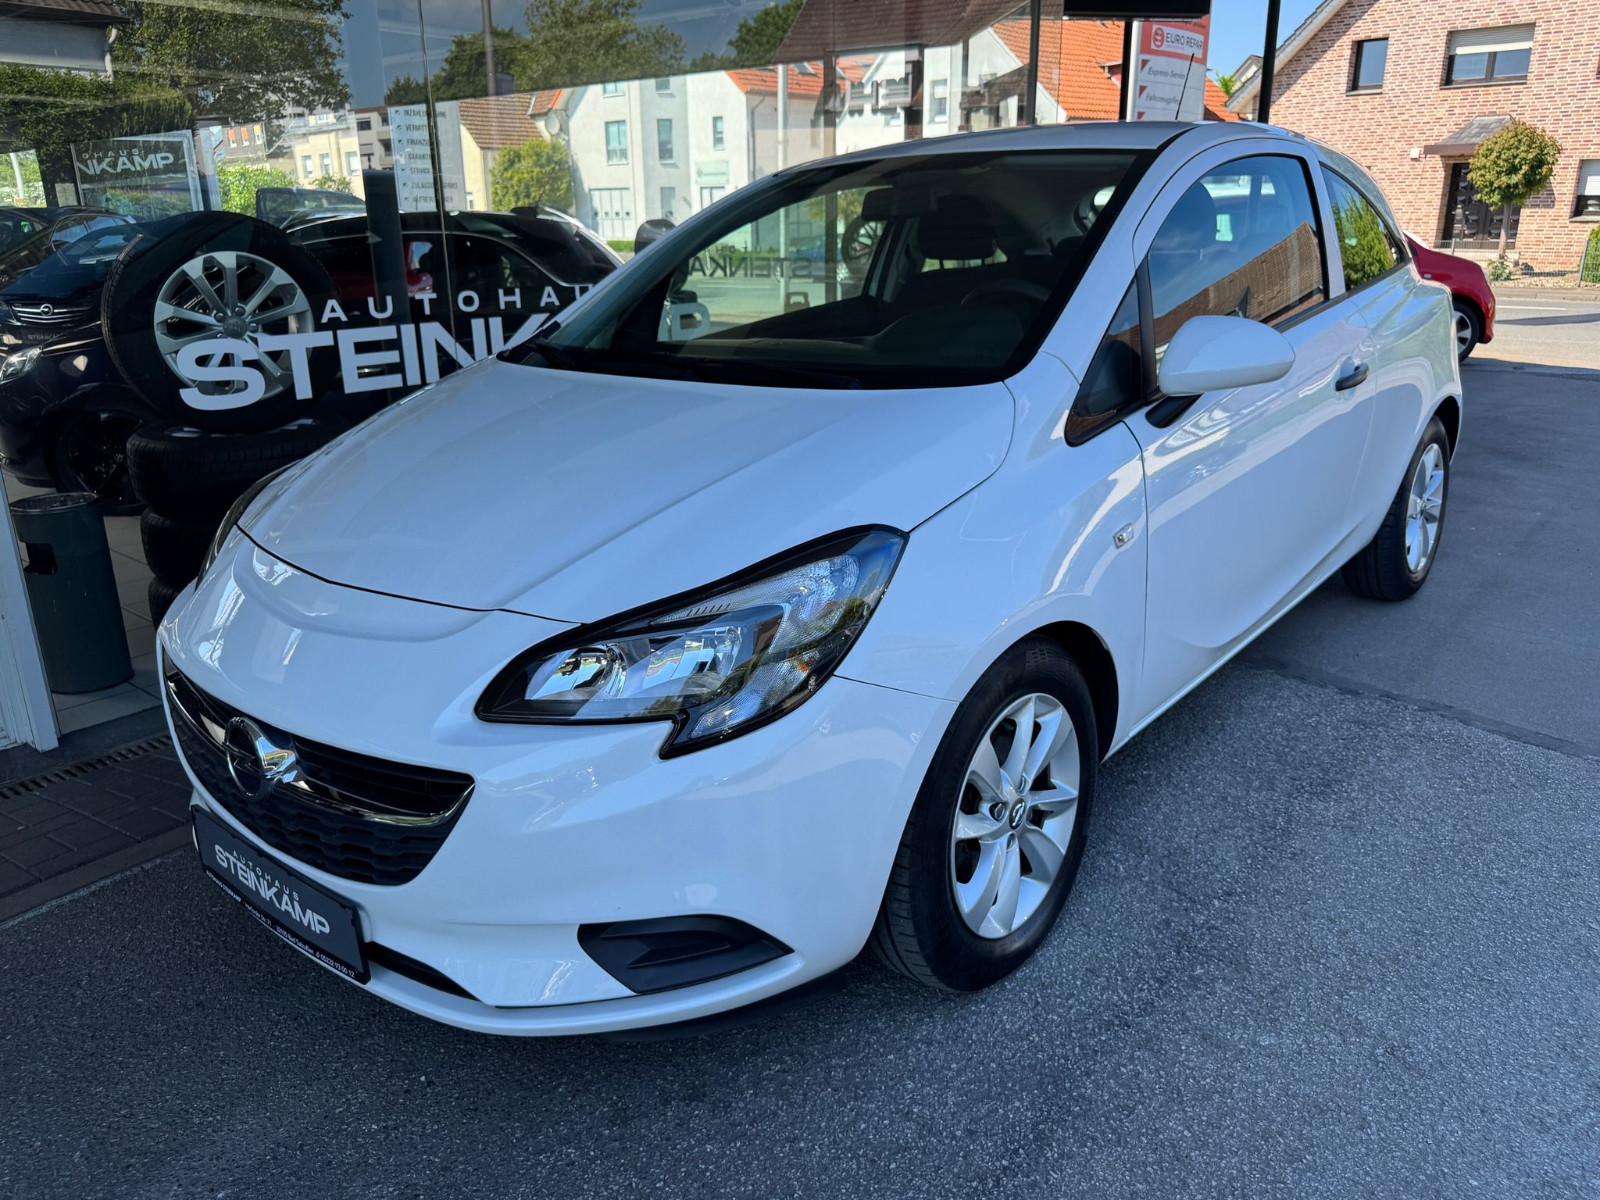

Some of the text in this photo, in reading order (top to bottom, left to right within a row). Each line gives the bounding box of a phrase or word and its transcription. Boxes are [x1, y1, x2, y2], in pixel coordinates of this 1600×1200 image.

[1166, 32, 1184, 45] EURO
[76, 152, 175, 175] NKAMP
[321, 283, 593, 324] AUTOHA
[214, 844, 330, 934] STEINKAMP
[233, 850, 299, 901] AUTOHAUS
